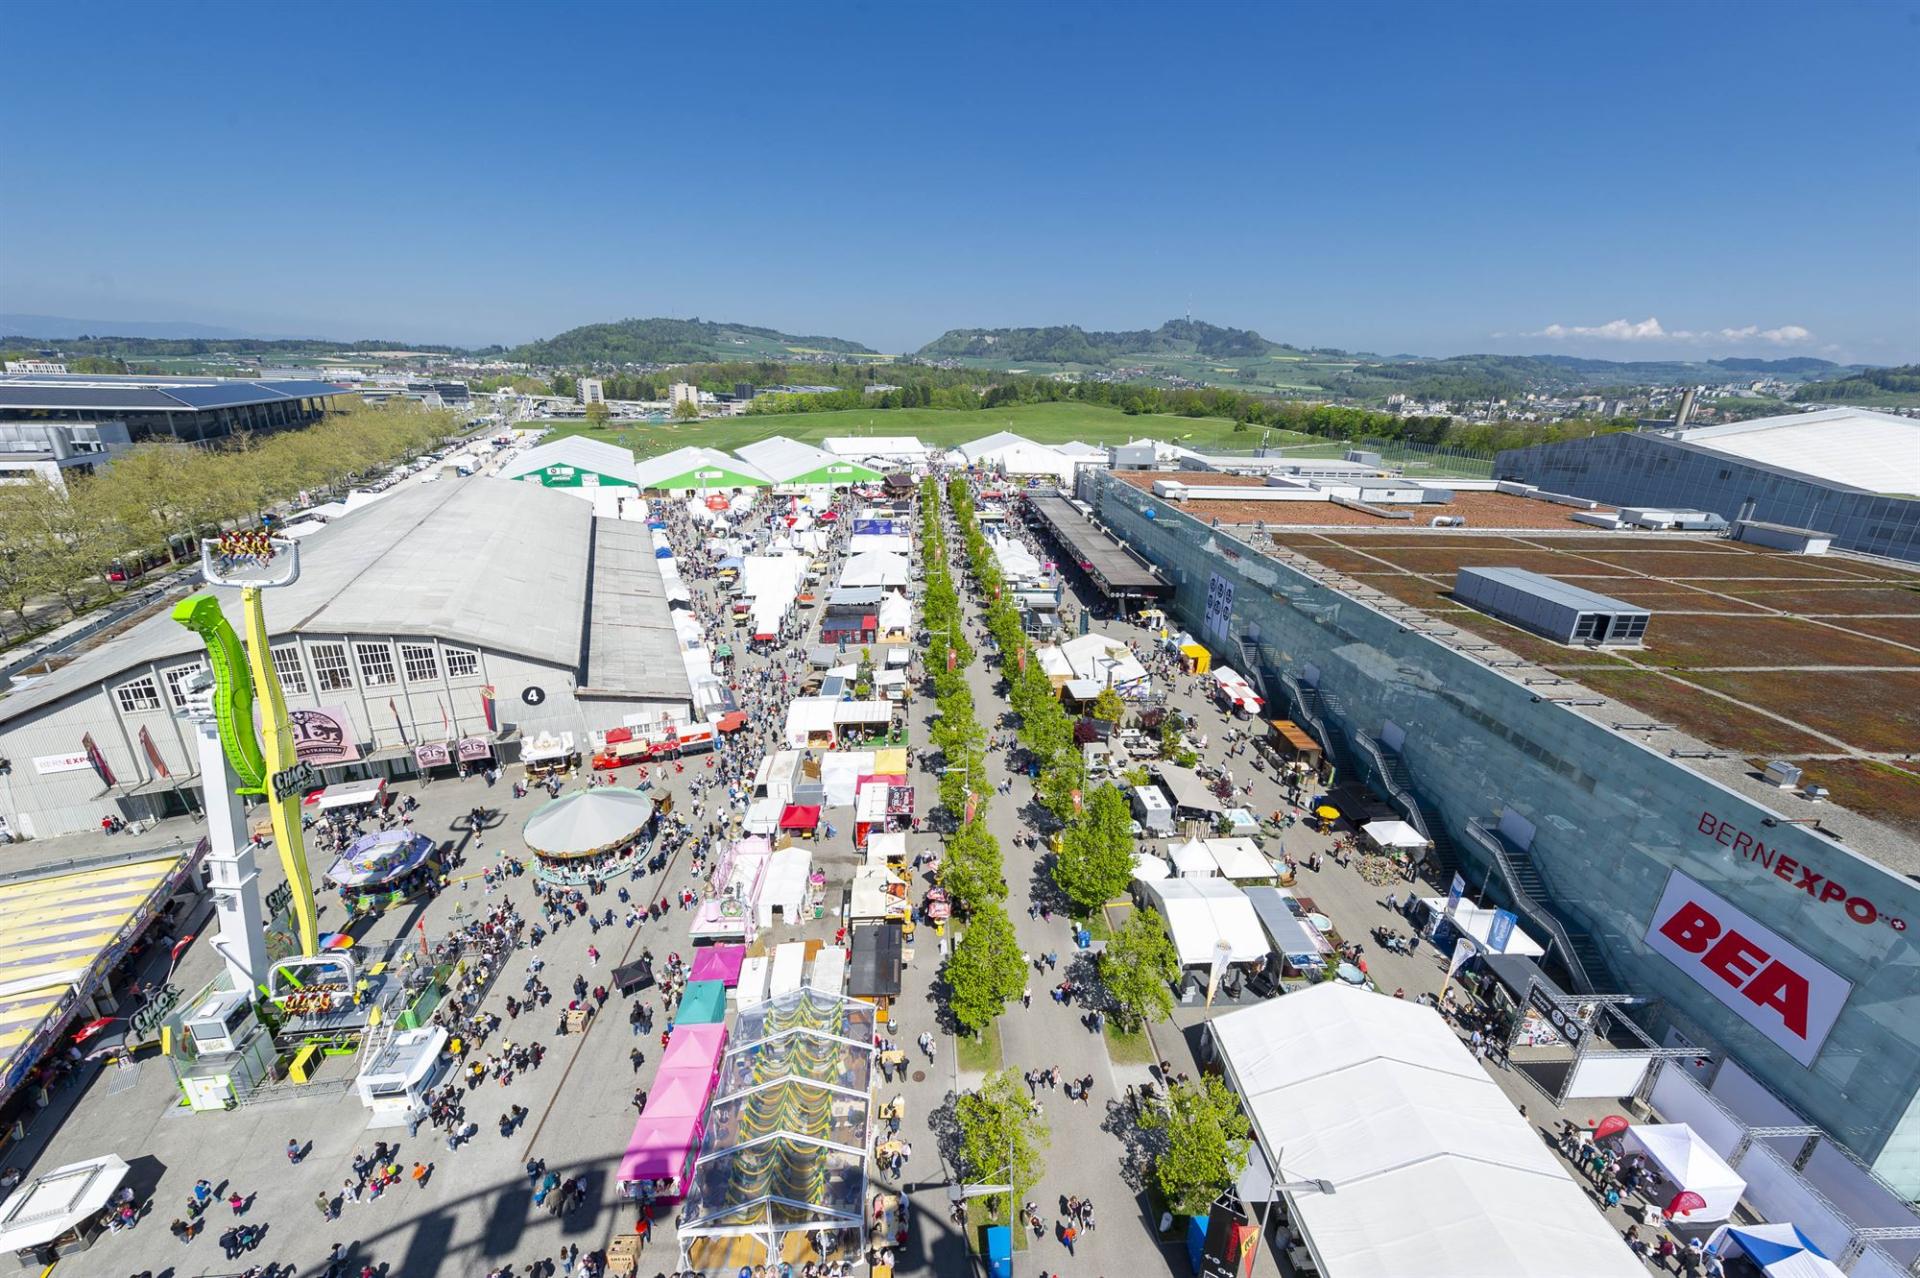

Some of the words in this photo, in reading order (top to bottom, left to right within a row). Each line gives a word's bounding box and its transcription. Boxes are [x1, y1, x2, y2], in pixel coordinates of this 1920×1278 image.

[528, 689, 539, 702] 4
[275, 760, 315, 789] CHAOS
[1697, 811, 1878, 925] BERNEXPO
[1658, 900, 1810, 1041] BEA
[133, 984, 180, 1030] CHAOS
